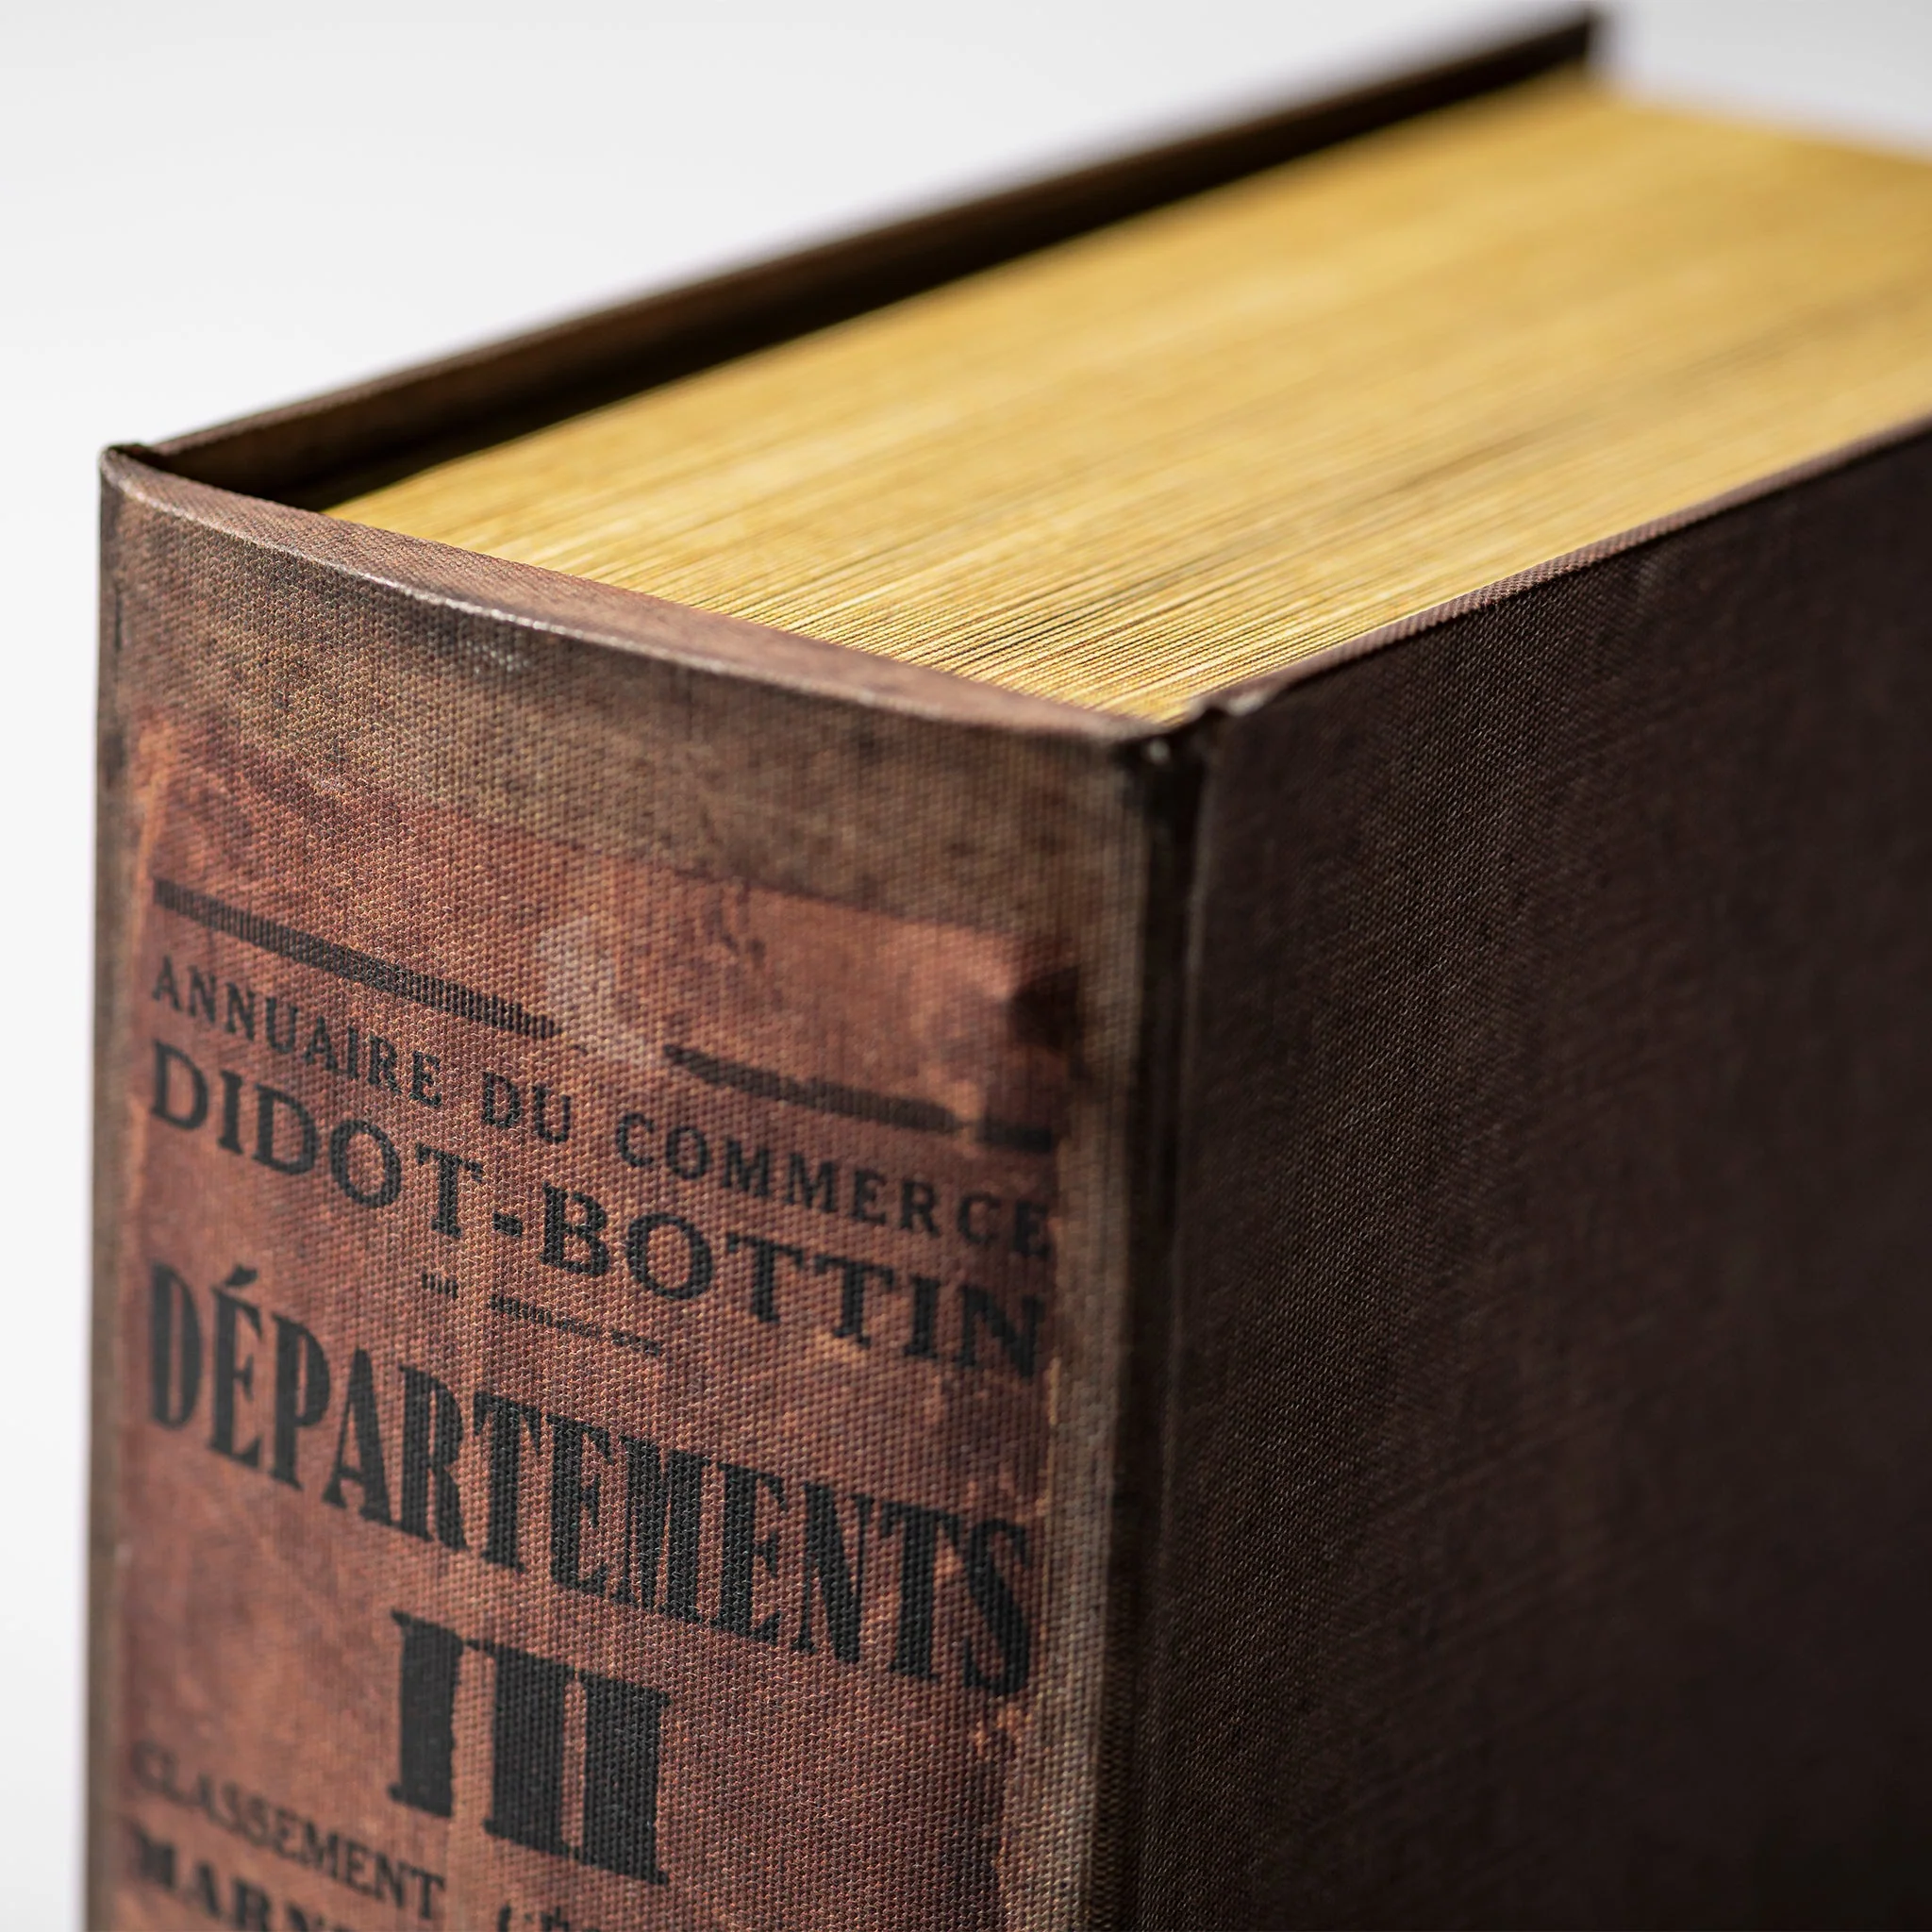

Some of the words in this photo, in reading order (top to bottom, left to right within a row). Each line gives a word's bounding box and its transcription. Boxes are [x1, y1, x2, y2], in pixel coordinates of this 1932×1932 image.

[151, 954, 443, 1109] ANNUAIRE
[481, 1071, 572, 1144] DU
[616, 1111, 1054, 1259] COMMERCE
[151, 1040, 1047, 1380] DIDOT-BOTTIN
[150, 1260, 1031, 1696] DÉPARTEMENTS
[388, 1608, 672, 1887] III
